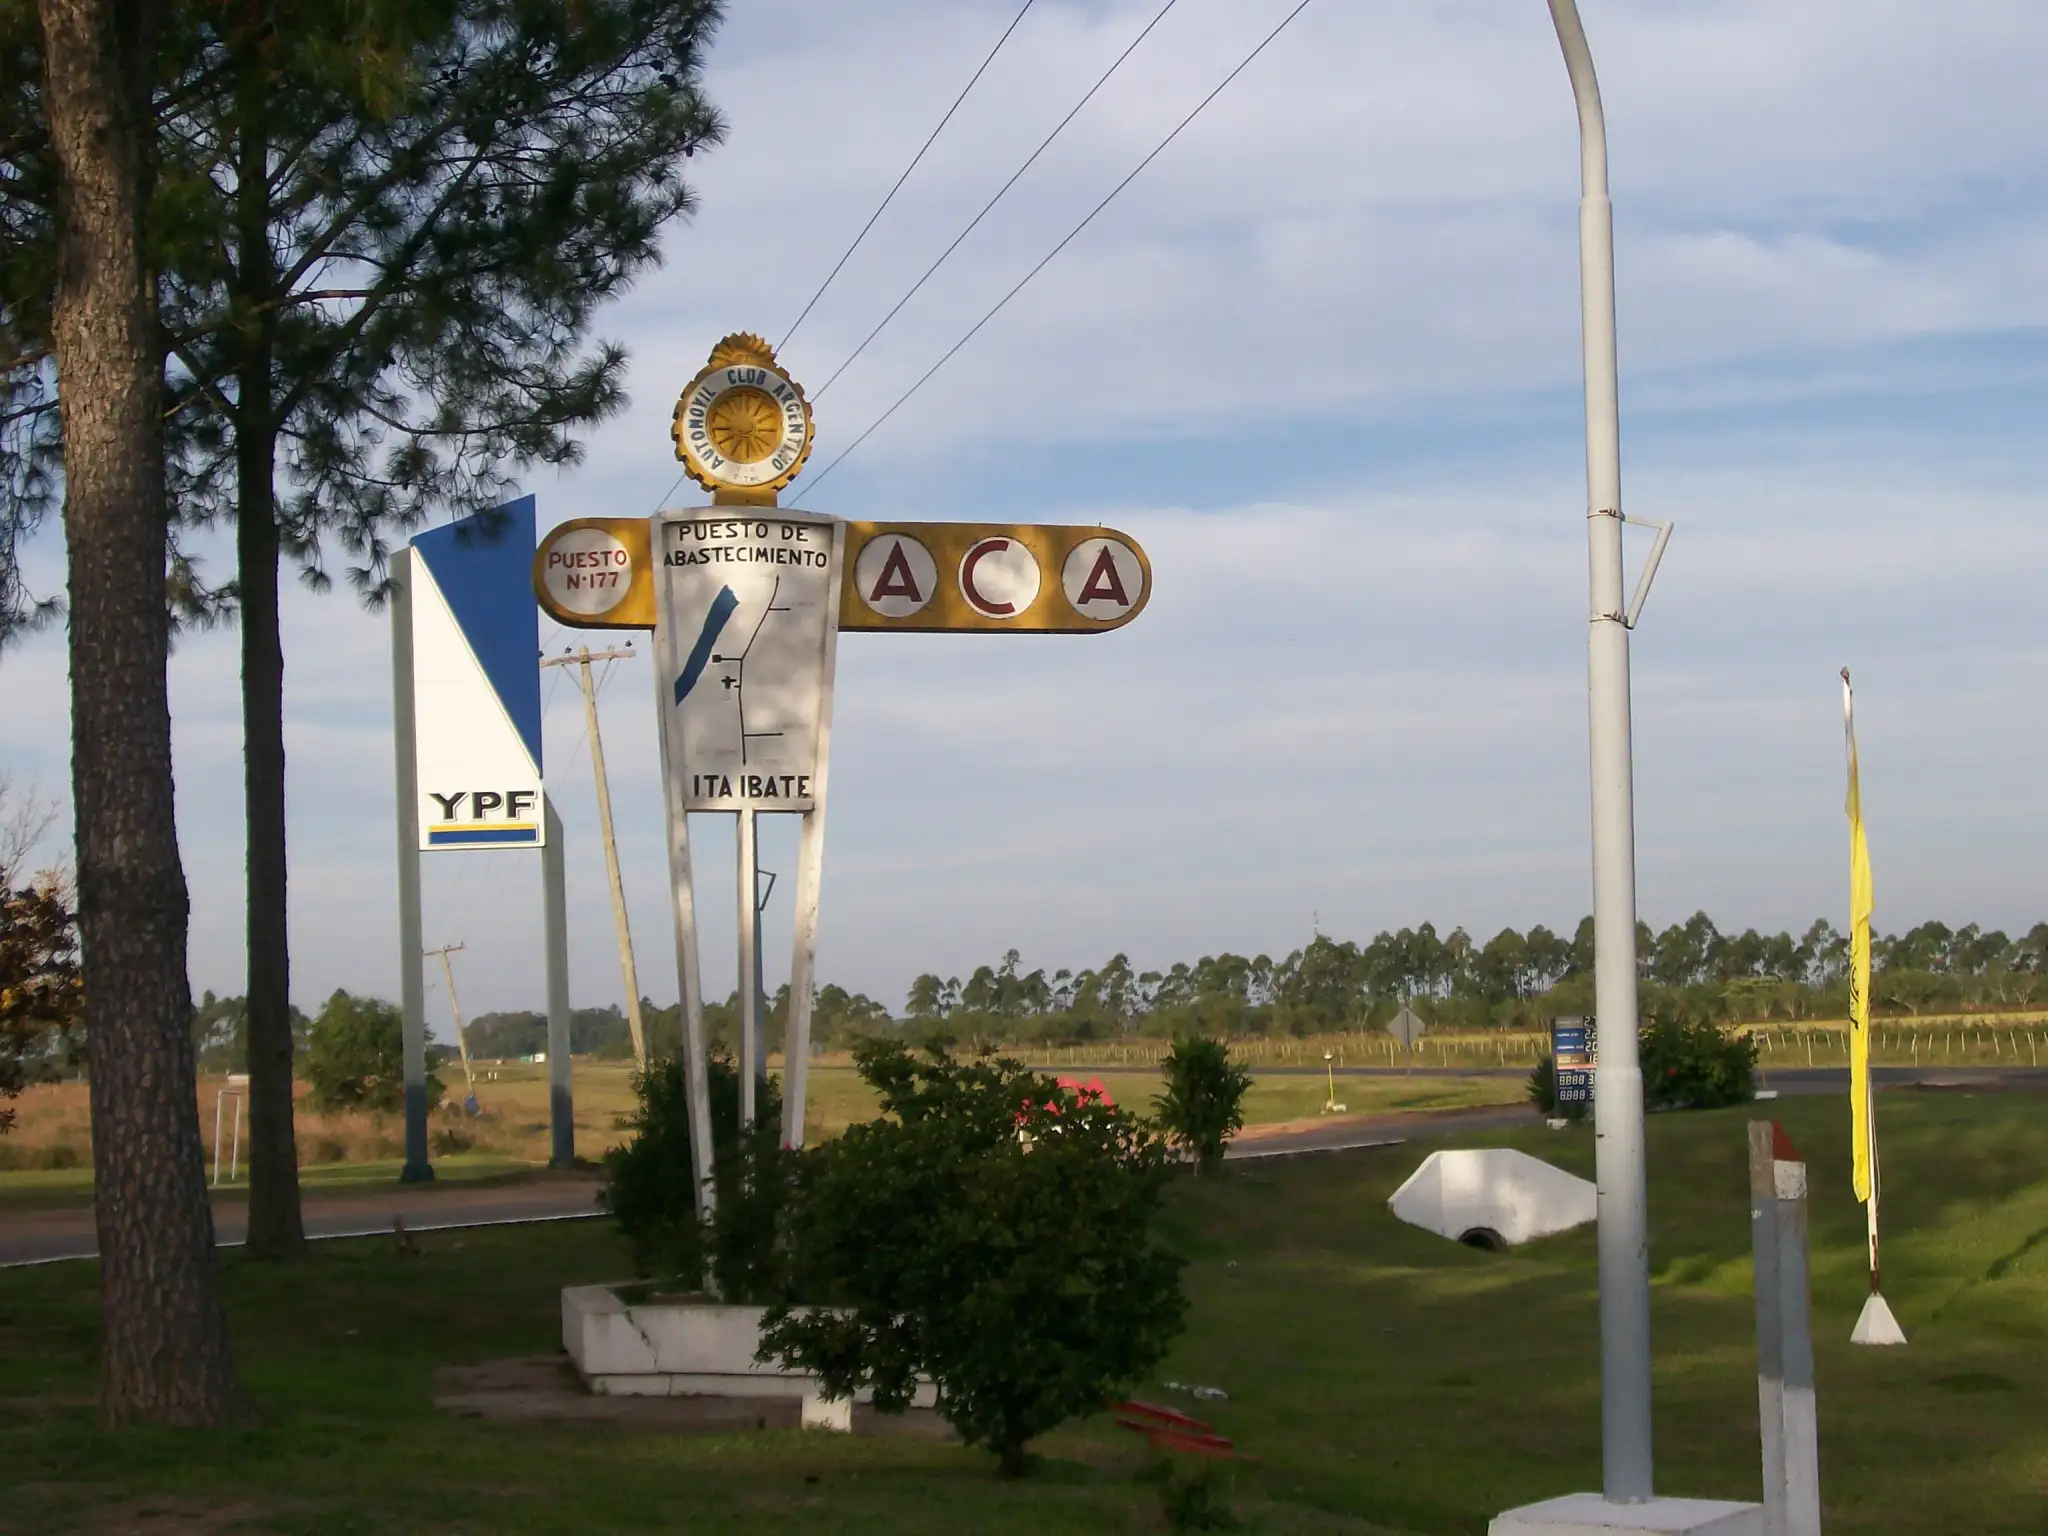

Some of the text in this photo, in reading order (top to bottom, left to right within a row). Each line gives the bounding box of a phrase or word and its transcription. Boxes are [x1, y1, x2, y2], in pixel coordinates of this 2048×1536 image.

[688, 387, 725, 471] AUTOMOVIL
[727, 369, 767, 386] CLUB
[679, 522, 809, 542] PUESTO DE
[548, 550, 627, 569] PUESTO
[663, 546, 827, 568] ABASTECIMIENTO
[693, 775, 811, 799] ITA IBATE
[428, 790, 537, 821] YPF
